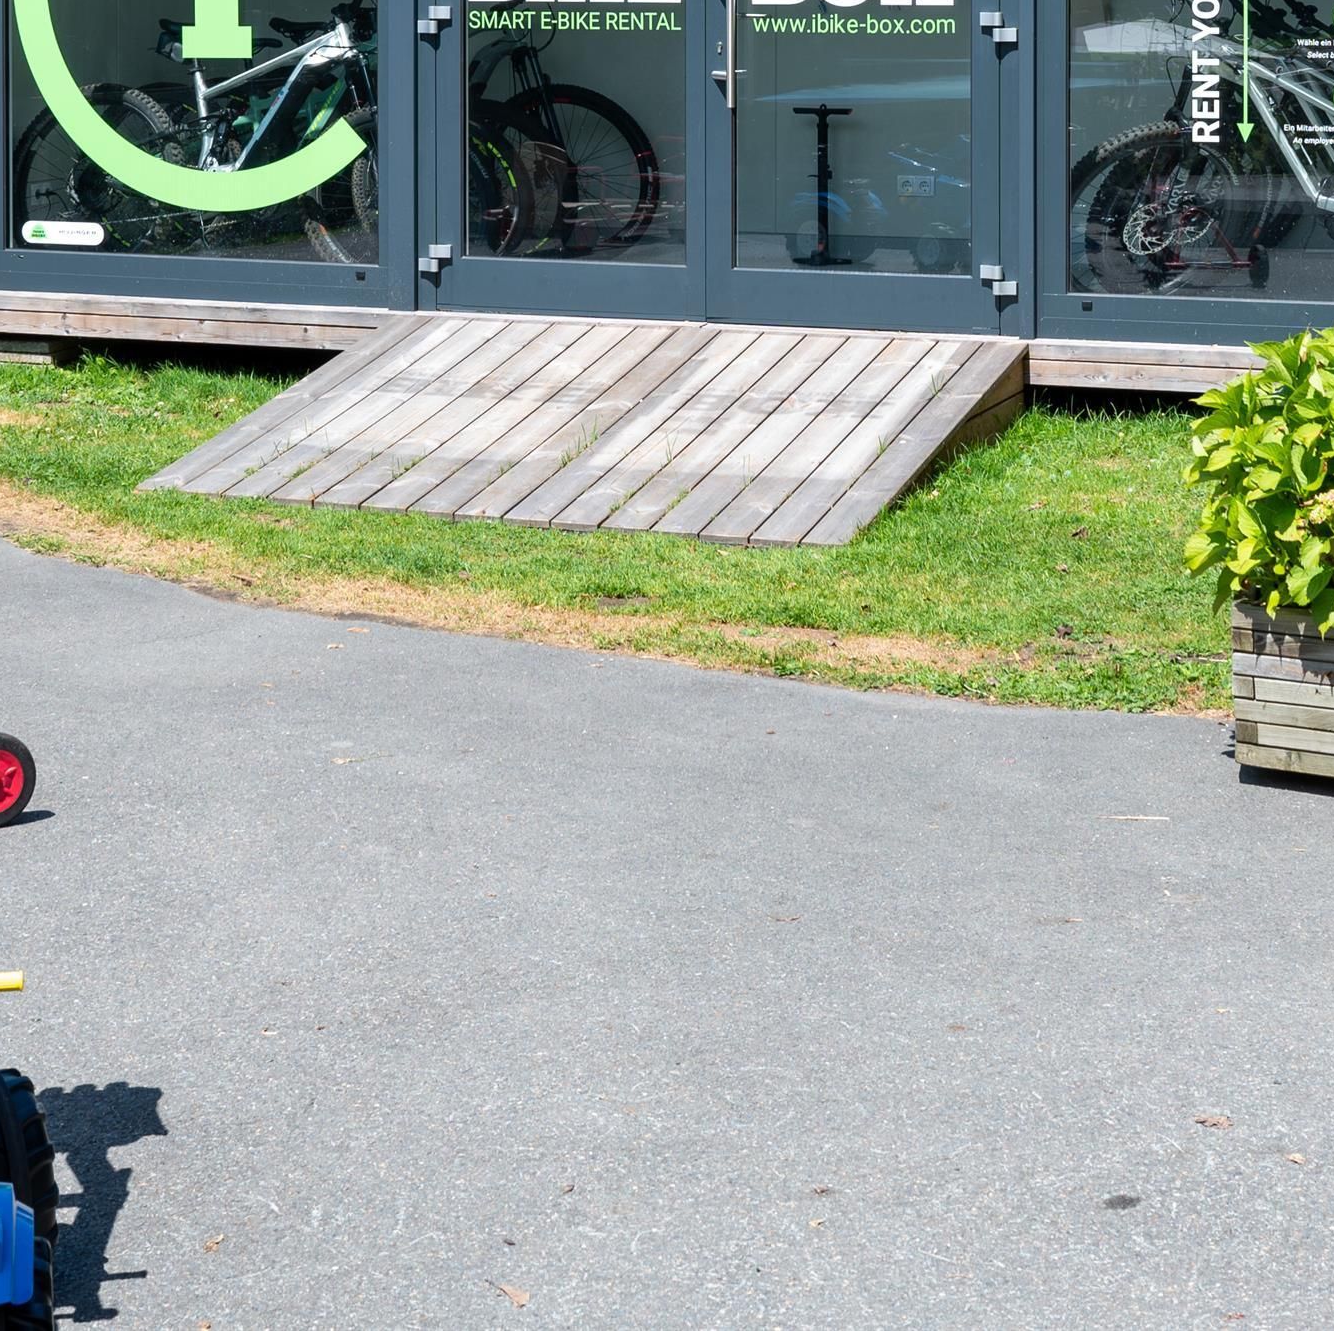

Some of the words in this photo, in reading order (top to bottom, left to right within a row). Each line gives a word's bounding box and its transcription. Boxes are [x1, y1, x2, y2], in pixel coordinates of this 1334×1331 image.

[468, 11, 535, 30] SMART
[540, 11, 600, 30] E-BIKE
[605, 12, 682, 31] RENTAL
[752, 14, 955, 35] www.ibike-box.com
[1297, 38, 1319, 47] Wähle
[1320, 39, 1332, 47] ein
[1307, 51, 1328, 59] Select
[1191, 50, 1220, 143] RENT
[1283, 124, 1295, 132] Ein
[1296, 124, 1334, 133] Mitarbeiter
